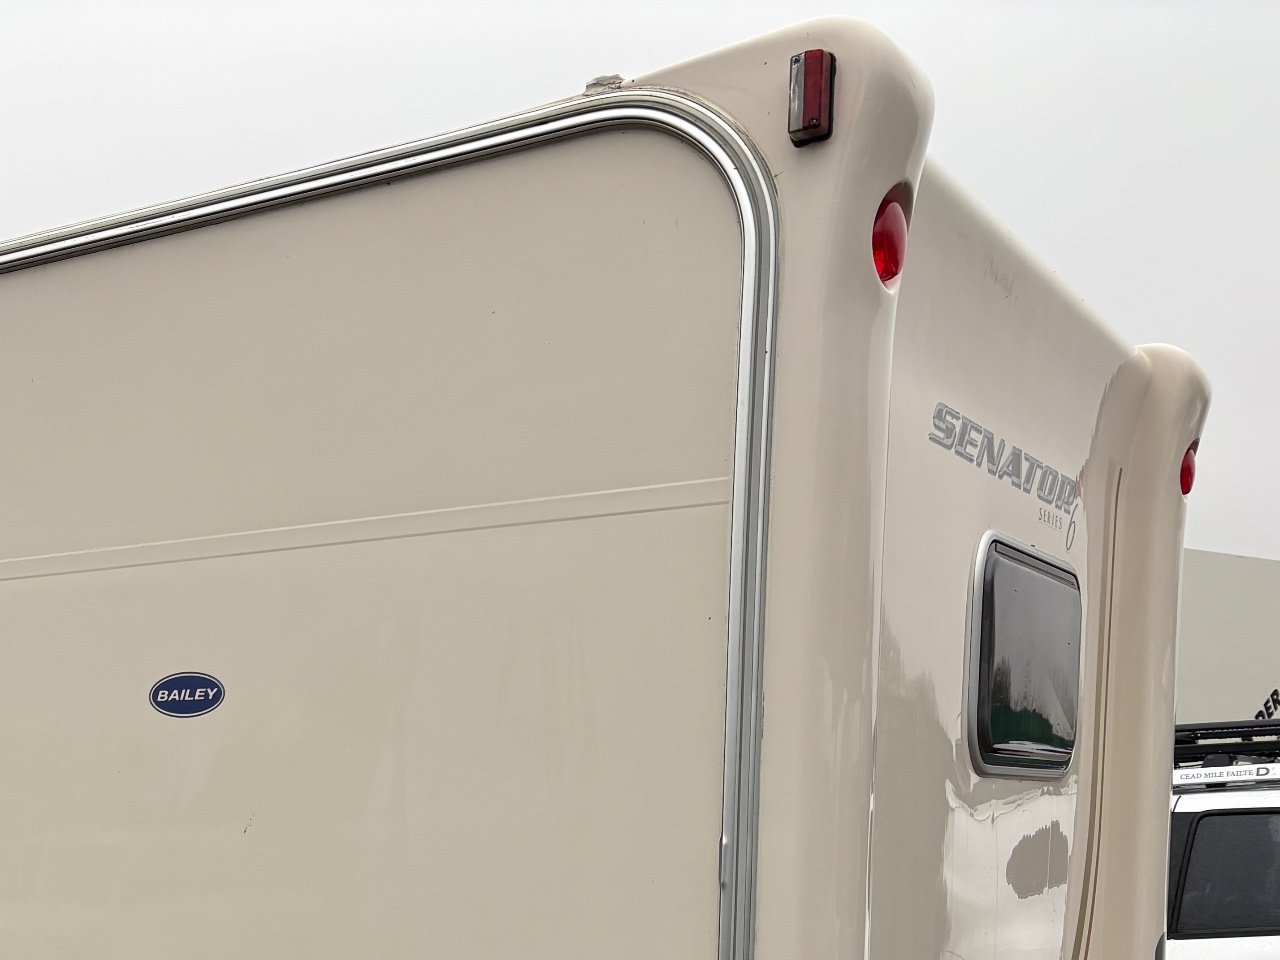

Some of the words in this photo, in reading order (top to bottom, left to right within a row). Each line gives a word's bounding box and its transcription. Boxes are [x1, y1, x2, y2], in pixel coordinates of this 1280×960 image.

[928, 402, 1078, 515] SENATOR
[1038, 507, 1063, 530] SERIES
[1065, 503, 1079, 551] 6
[157, 687, 218, 702] BAILEY
[1180, 772, 1202, 780] CEAD
[1204, 771, 1224, 779] MILE
[1226, 769, 1254, 778] FAILTE
